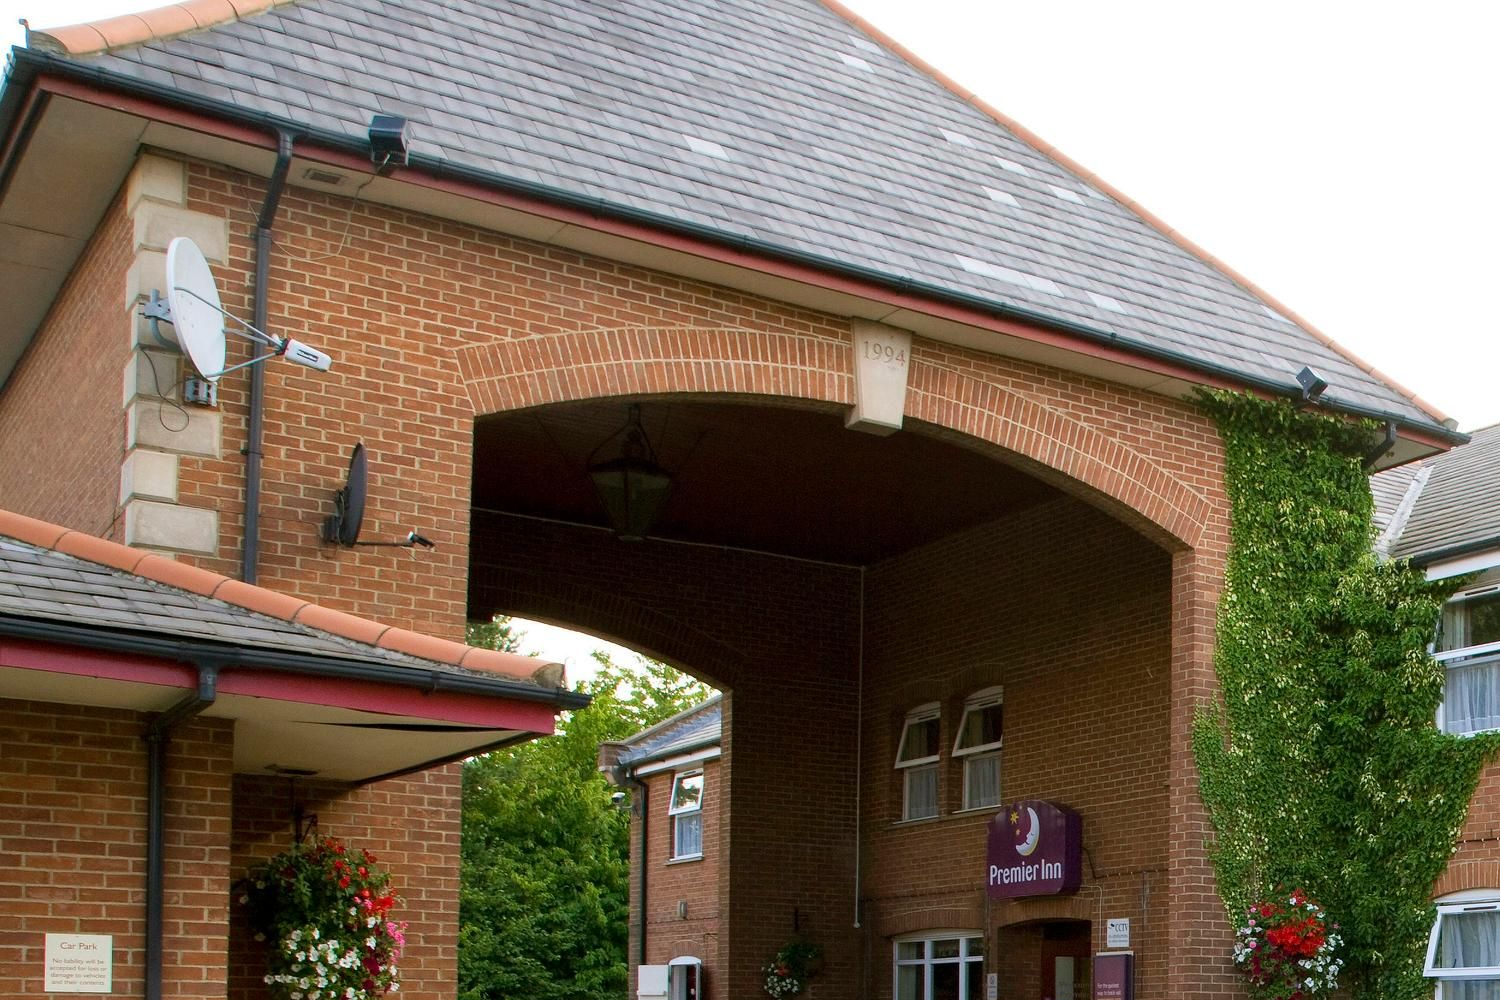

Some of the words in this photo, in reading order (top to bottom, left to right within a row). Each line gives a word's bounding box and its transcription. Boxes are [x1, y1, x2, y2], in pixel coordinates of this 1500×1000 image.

[863, 340, 906, 367] 1994
[989, 861, 1039, 886] Premier
[1041, 858, 1062, 880] Inn
[1115, 923, 1128, 932] CCTV
[60, 941, 76, 950] Car
[79, 942, 98, 950] Park
